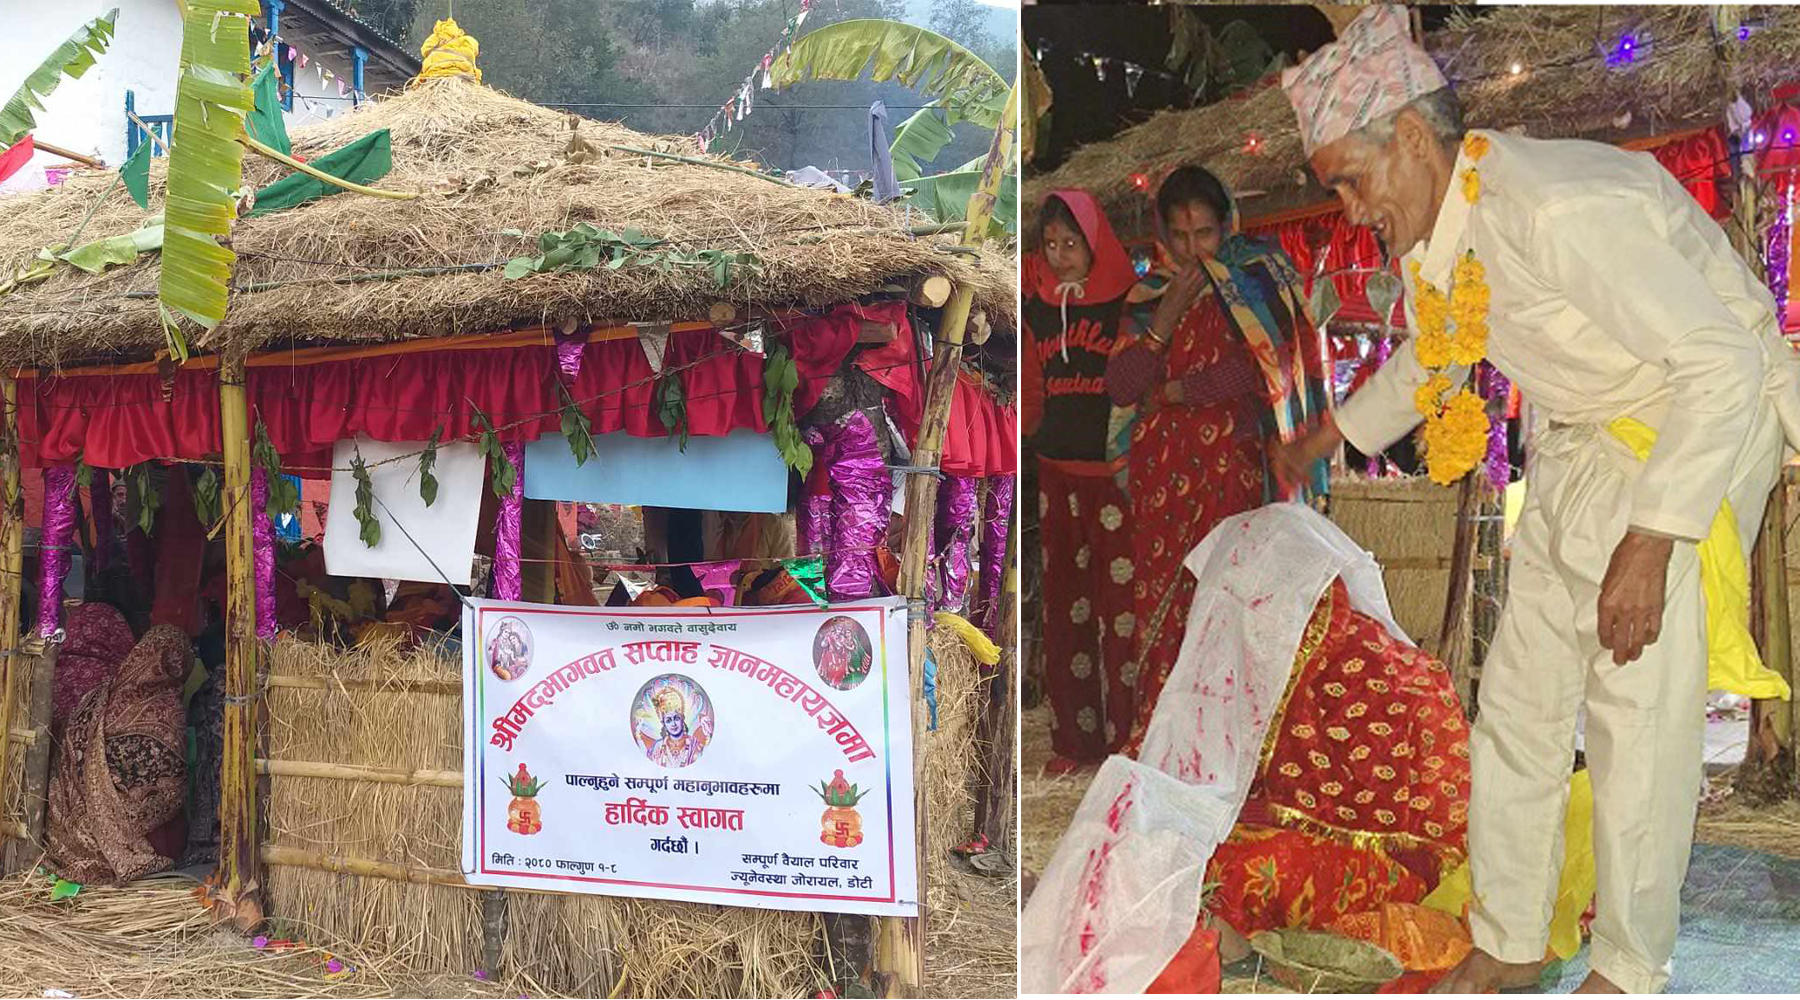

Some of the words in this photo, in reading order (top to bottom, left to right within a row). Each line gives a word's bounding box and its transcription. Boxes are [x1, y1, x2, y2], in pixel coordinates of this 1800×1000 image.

[623, 621, 645, 632] नमो
[647, 622, 683, 633] भगवते
[687, 621, 738, 636] वासुदेवाय
[621, 641, 701, 665] सप्ताह
[604, 797, 670, 826] हार्दिक
[676, 806, 745, 831] स्वागत
[491, 852, 514, 866] मिति
[525, 857, 552, 868] २०८०
[819, 855, 860, 870] परिवार
[847, 875, 874, 889] डोटी
